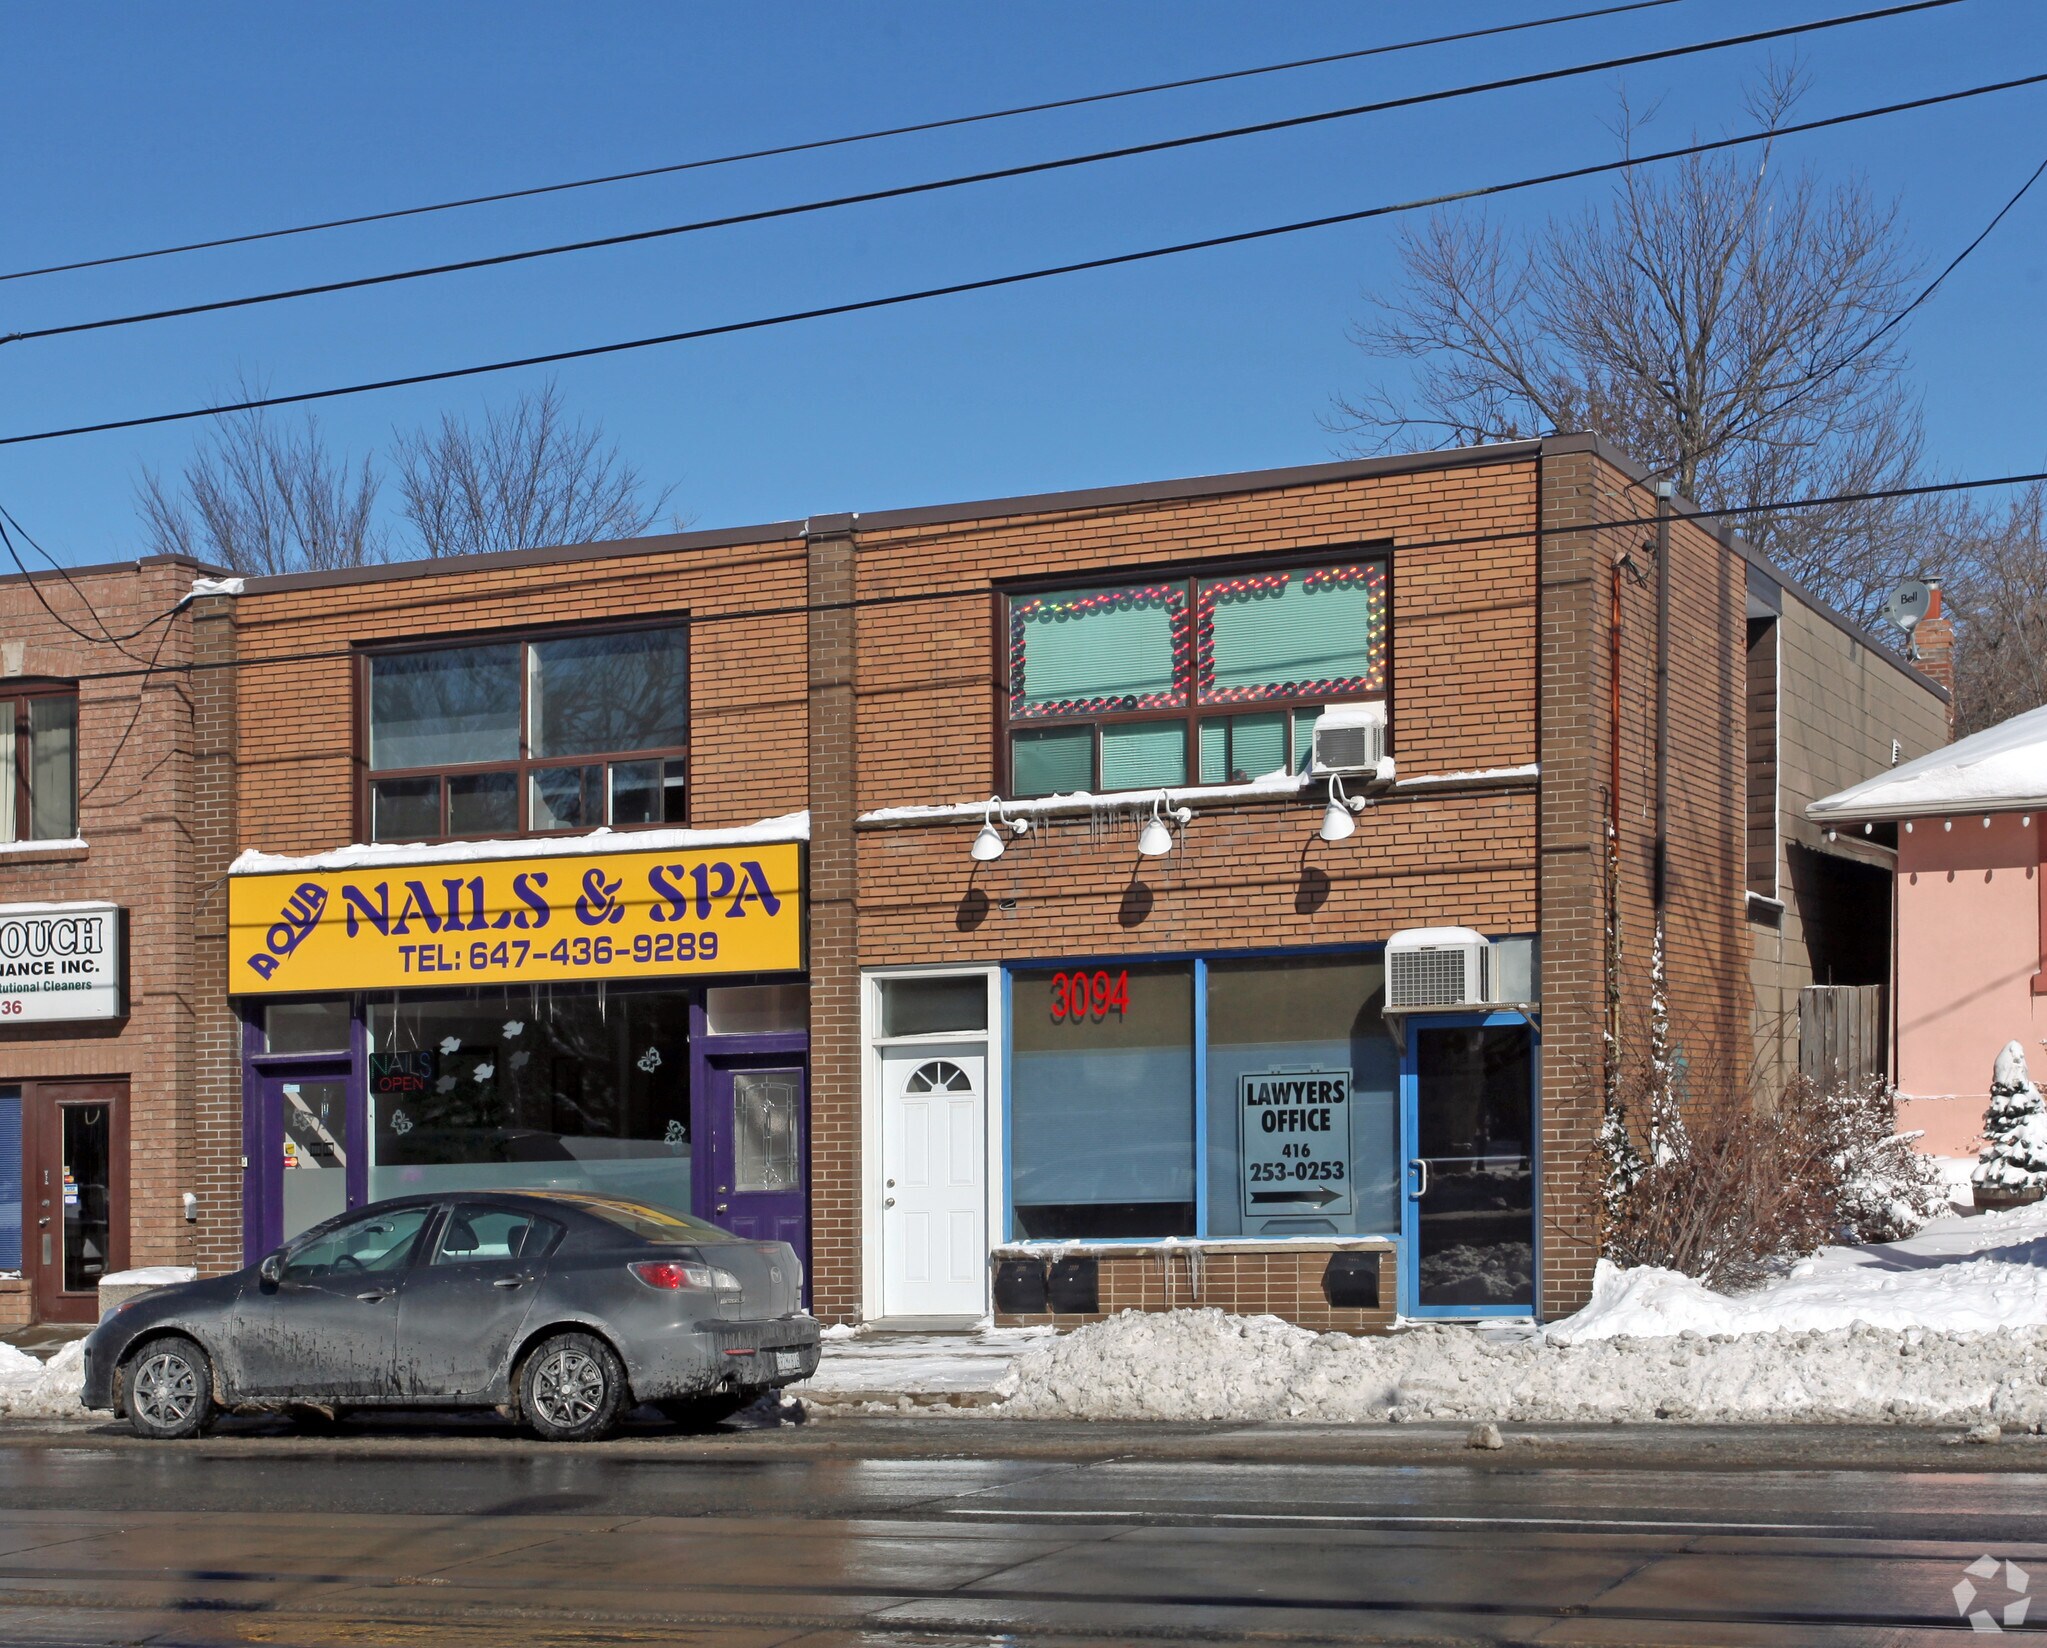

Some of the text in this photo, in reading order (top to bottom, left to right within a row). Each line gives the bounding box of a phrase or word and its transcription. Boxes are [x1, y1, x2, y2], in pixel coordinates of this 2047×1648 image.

[1901, 591, 1918, 605] Bell
[342, 861, 781, 938] NAILS & SPA
[247, 882, 329, 981] AQUA
[398, 931, 719, 972] TEL: 647-436-9289
[61, 959, 100, 974] INC.
[43, 980, 92, 992] Cleaners
[1051, 969, 1130, 1017] 3094
[1, 1000, 22, 1015] 36
[371, 1052, 431, 1079] NAILS
[380, 1076, 424, 1091] OPEN
[1247, 1080, 1345, 1106] LAWYERS
[1261, 1108, 1331, 1133] OFFICE
[1282, 1143, 1311, 1158] 416
[1249, 1161, 1345, 1182] 253-0253
